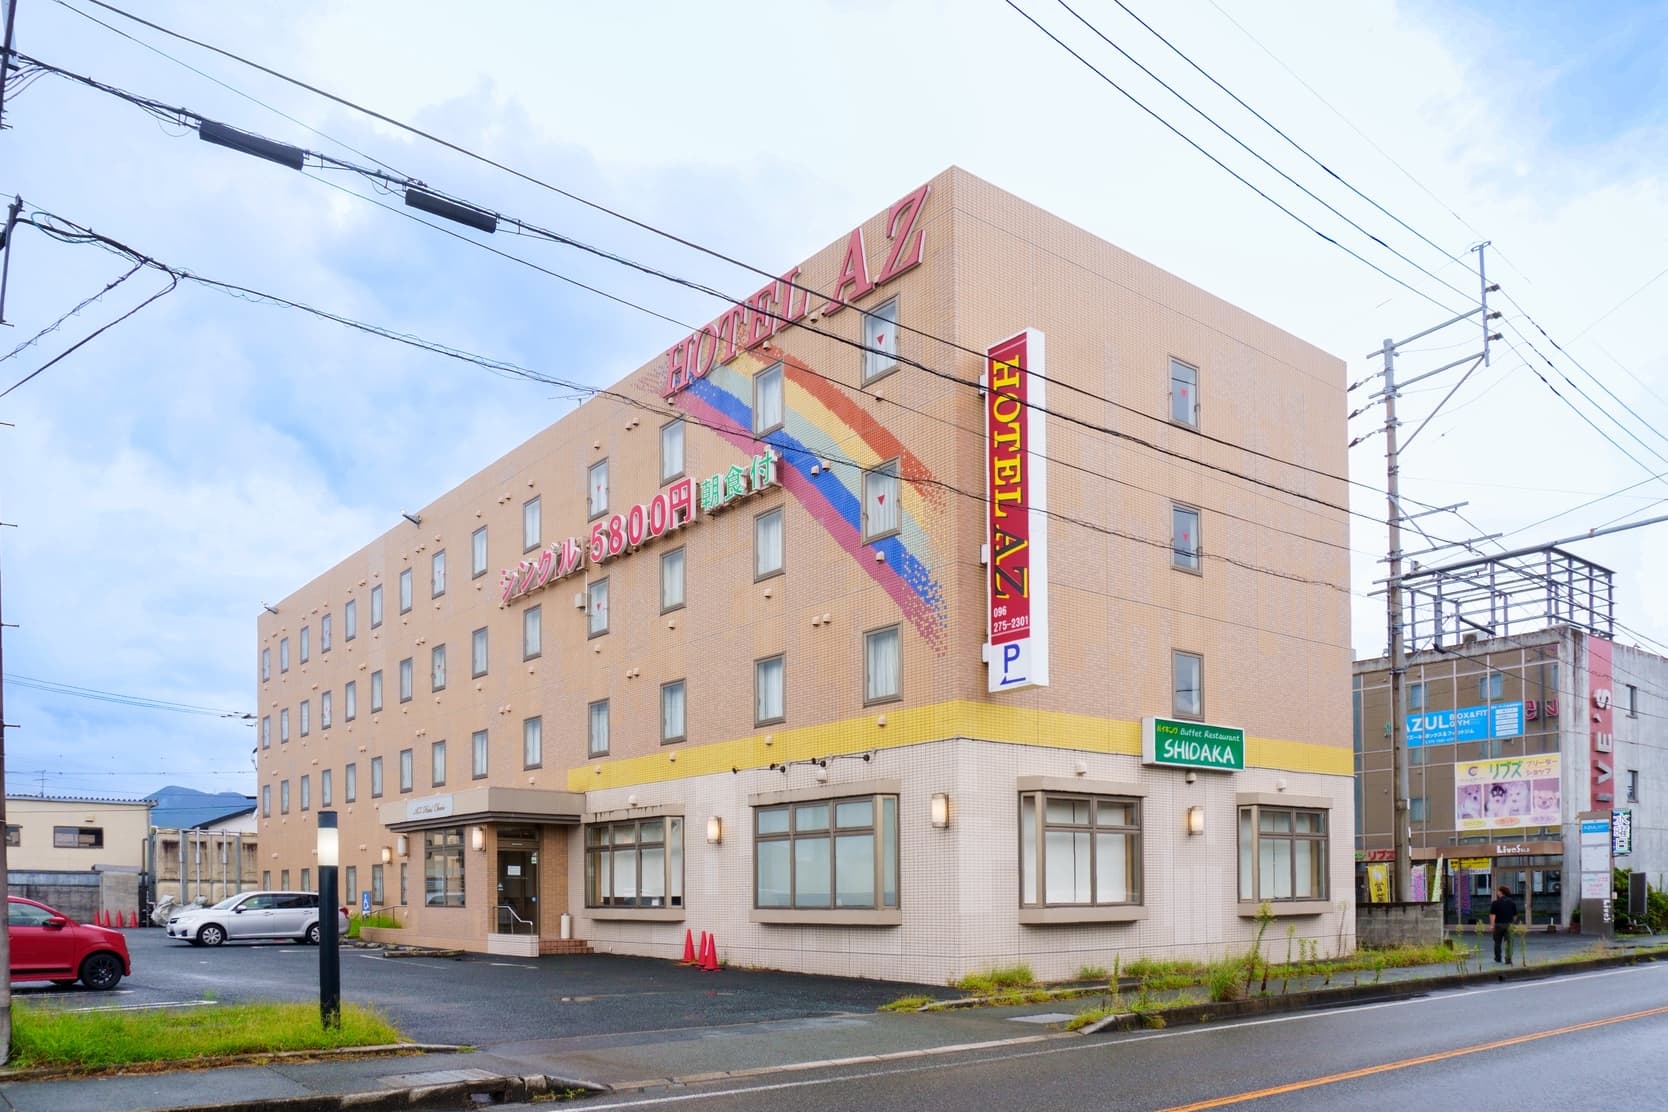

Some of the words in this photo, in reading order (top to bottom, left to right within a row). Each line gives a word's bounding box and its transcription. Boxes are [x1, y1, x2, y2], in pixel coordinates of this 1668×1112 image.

[662, 265, 811, 399] HOTEL
[821, 183, 932, 317] AZ
[993, 354, 1023, 519] HOTEL
[500, 537, 582, 603] シングル
[590, 476, 697, 564] 5800円
[700, 446, 780, 511] 朝食付
[993, 523, 1029, 600] AZ
[993, 606, 1007, 618] 096
[993, 615, 1029, 633] 275-2301
[1004, 643, 1020, 674] P
[1180, 727, 1202, 738] Buffet
[1203, 730, 1241, 742] Restaurant
[1593, 688, 1612, 803] IVE'S
[1163, 738, 1235, 765] SHIDAKA
[1489, 760, 1524, 780] リブズ
